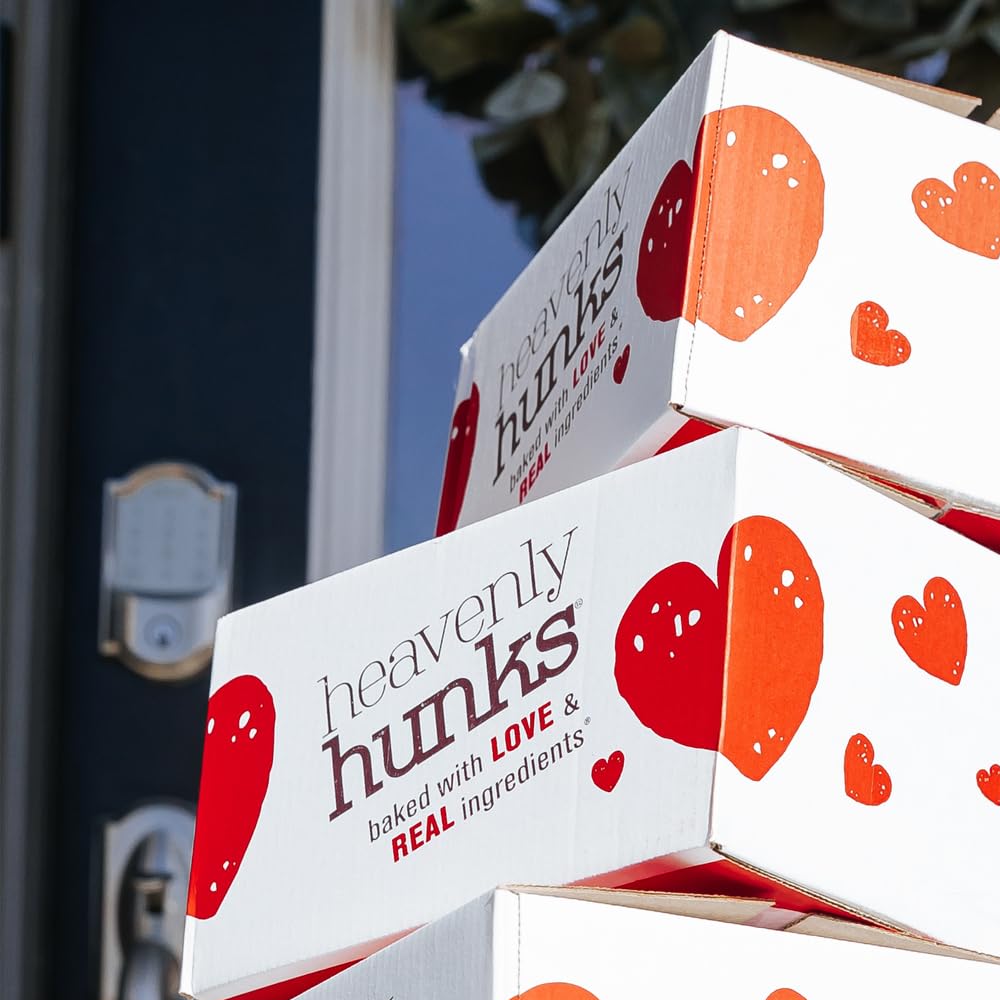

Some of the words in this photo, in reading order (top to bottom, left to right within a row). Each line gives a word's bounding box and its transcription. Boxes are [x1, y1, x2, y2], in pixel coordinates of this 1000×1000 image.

[498, 161, 633, 412] heavenly
[510, 427, 542, 493] baked
[545, 388, 569, 435] with
[572, 321, 606, 389] LOVE
[519, 442, 552, 505] REAL
[317, 526, 579, 738] heavenly
[368, 784, 430, 842] baked
[437, 754, 483, 797] with
[490, 701, 554, 762] LOVE
[564, 693, 580, 716] &
[391, 805, 455, 863] REAL
